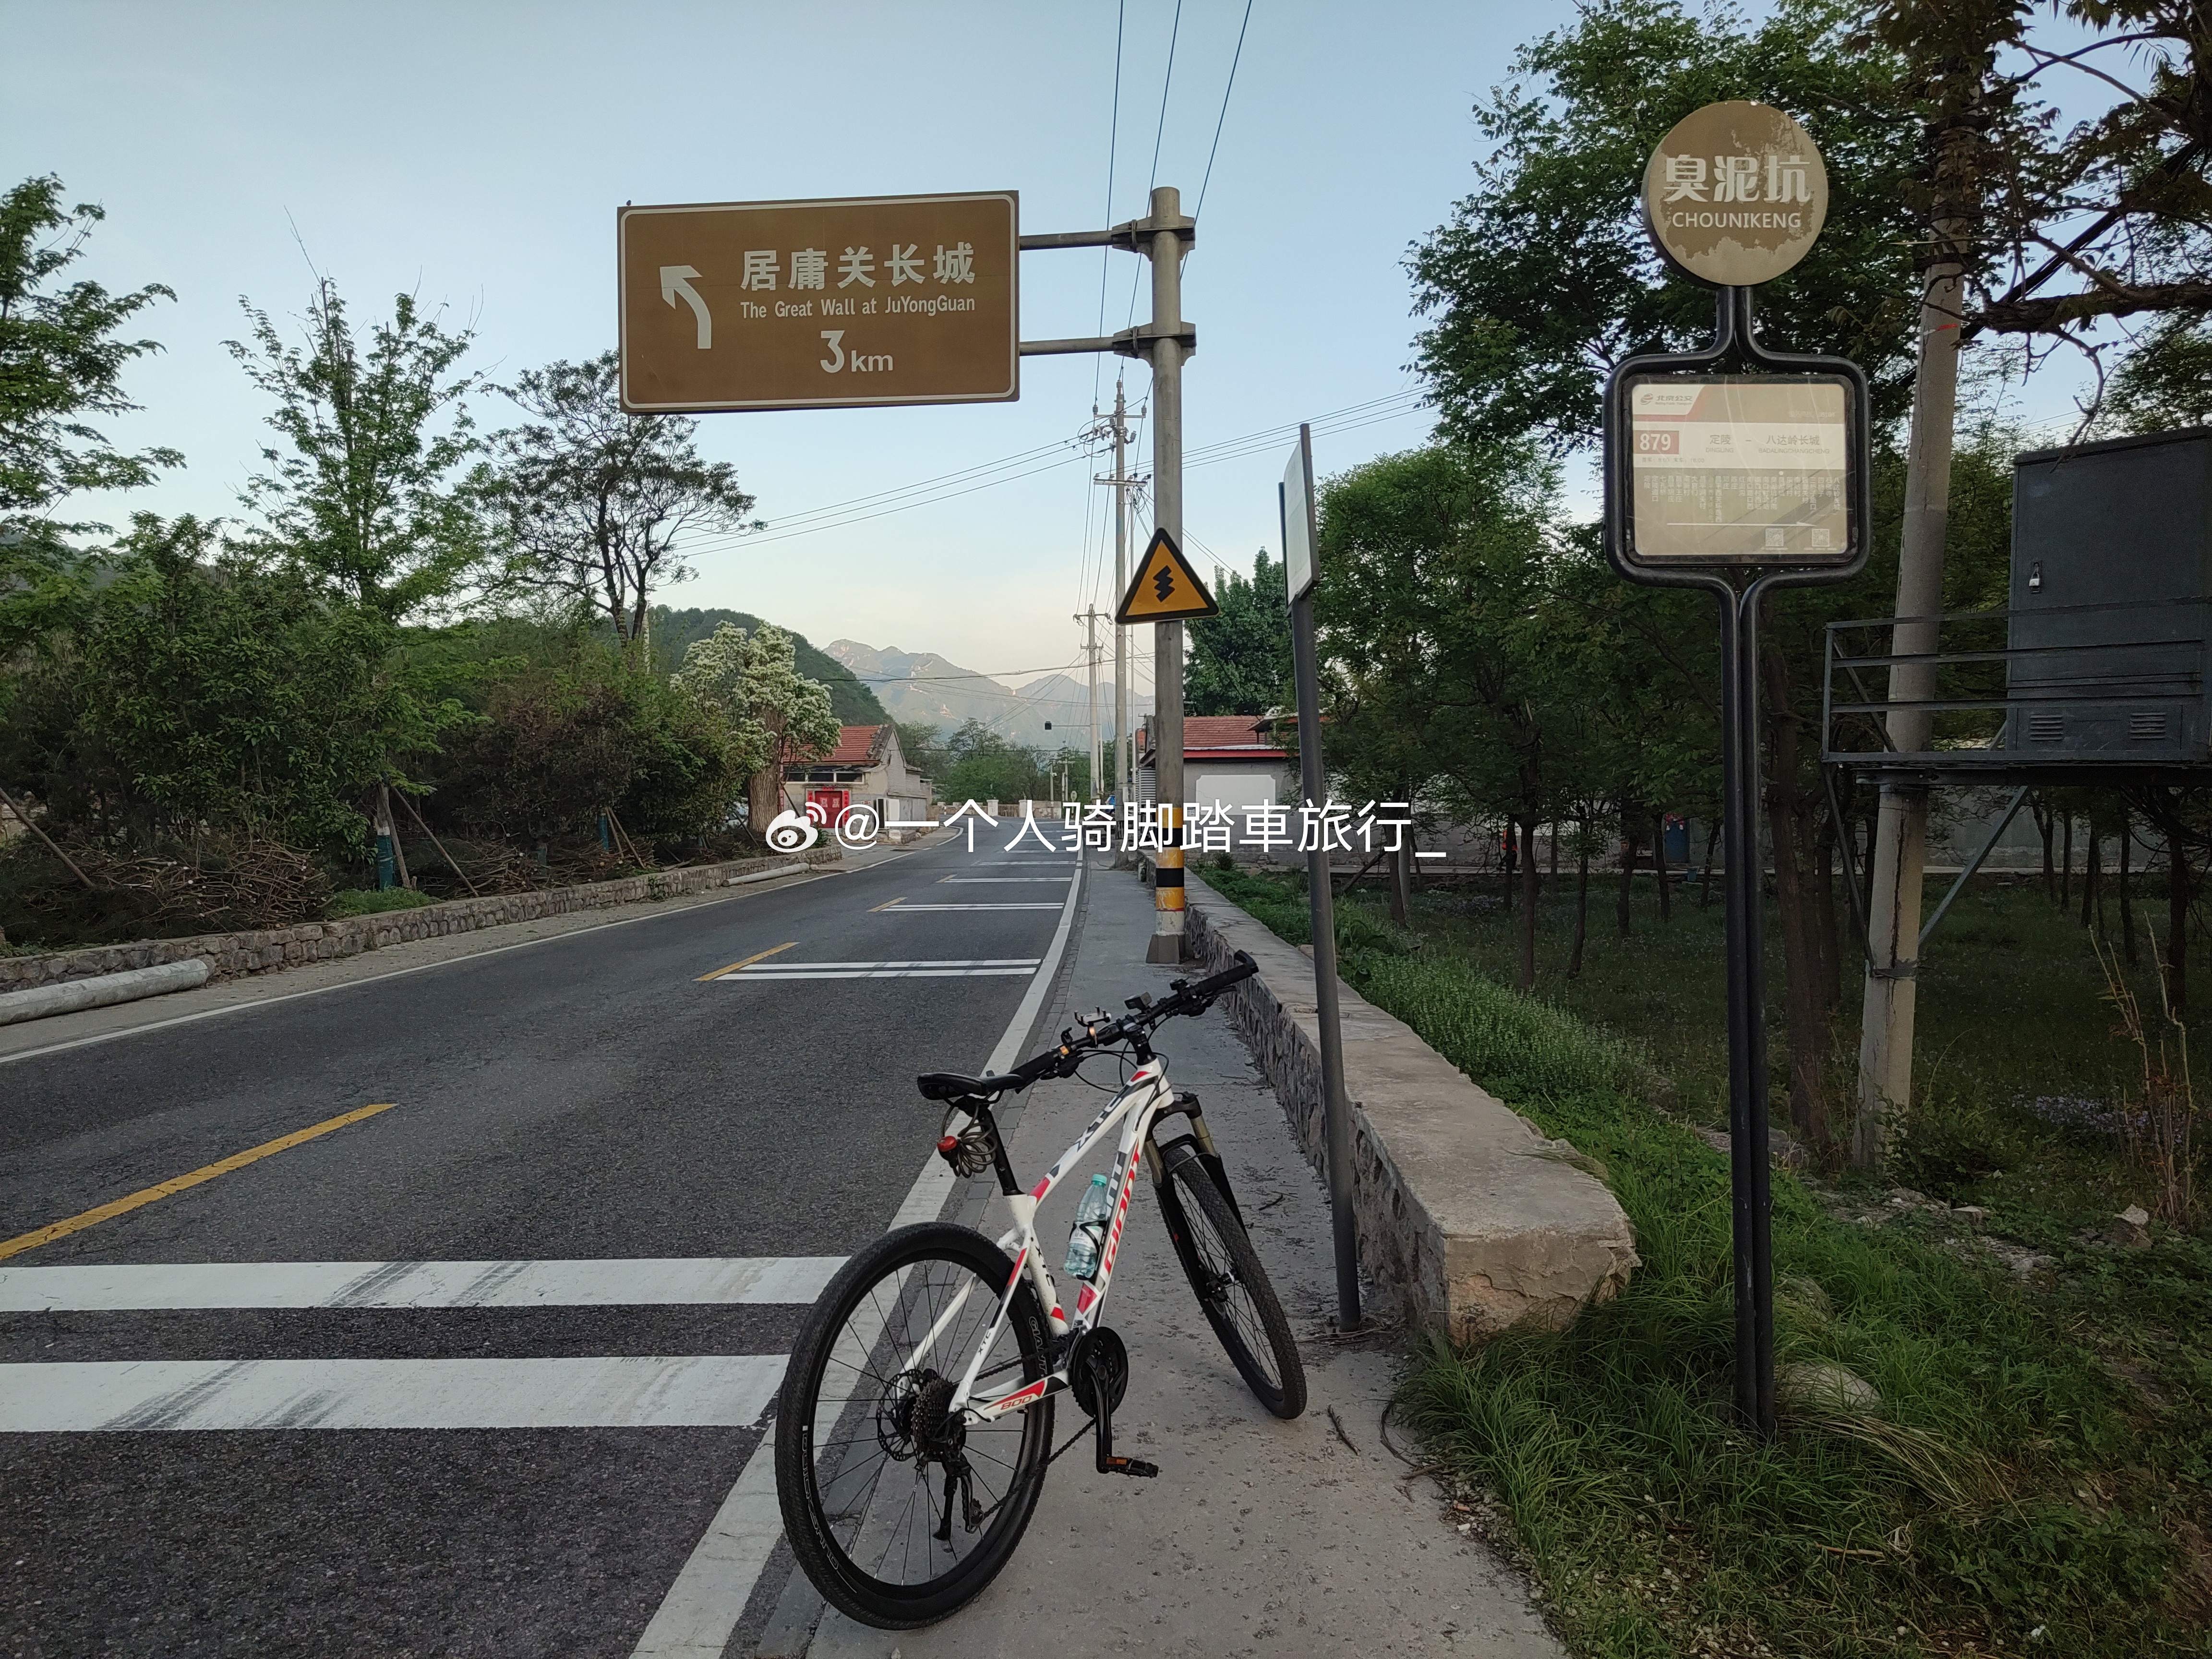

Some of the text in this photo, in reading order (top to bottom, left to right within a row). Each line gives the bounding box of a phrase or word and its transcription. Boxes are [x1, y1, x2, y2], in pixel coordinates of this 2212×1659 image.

[1663, 154, 1811, 203] 臭泥坑
[1672, 212, 1801, 228] CHOUNIKENG
[740, 242, 975, 291] 居庸关长城
[740, 294, 975, 319] The Great Wall at JuYongGuan
[820, 330, 893, 373] 3 km
[1639, 433, 1671, 451] 879
[1709, 434, 1731, 445] 定陵
[1766, 435, 1820, 445] 八达岭长城
[1075, 1094, 1122, 1147] XTC
[978, 1331, 991, 1356] XTC
[1028, 1316, 1048, 1375] GIANT
[1000, 1395, 1033, 1410] 800
